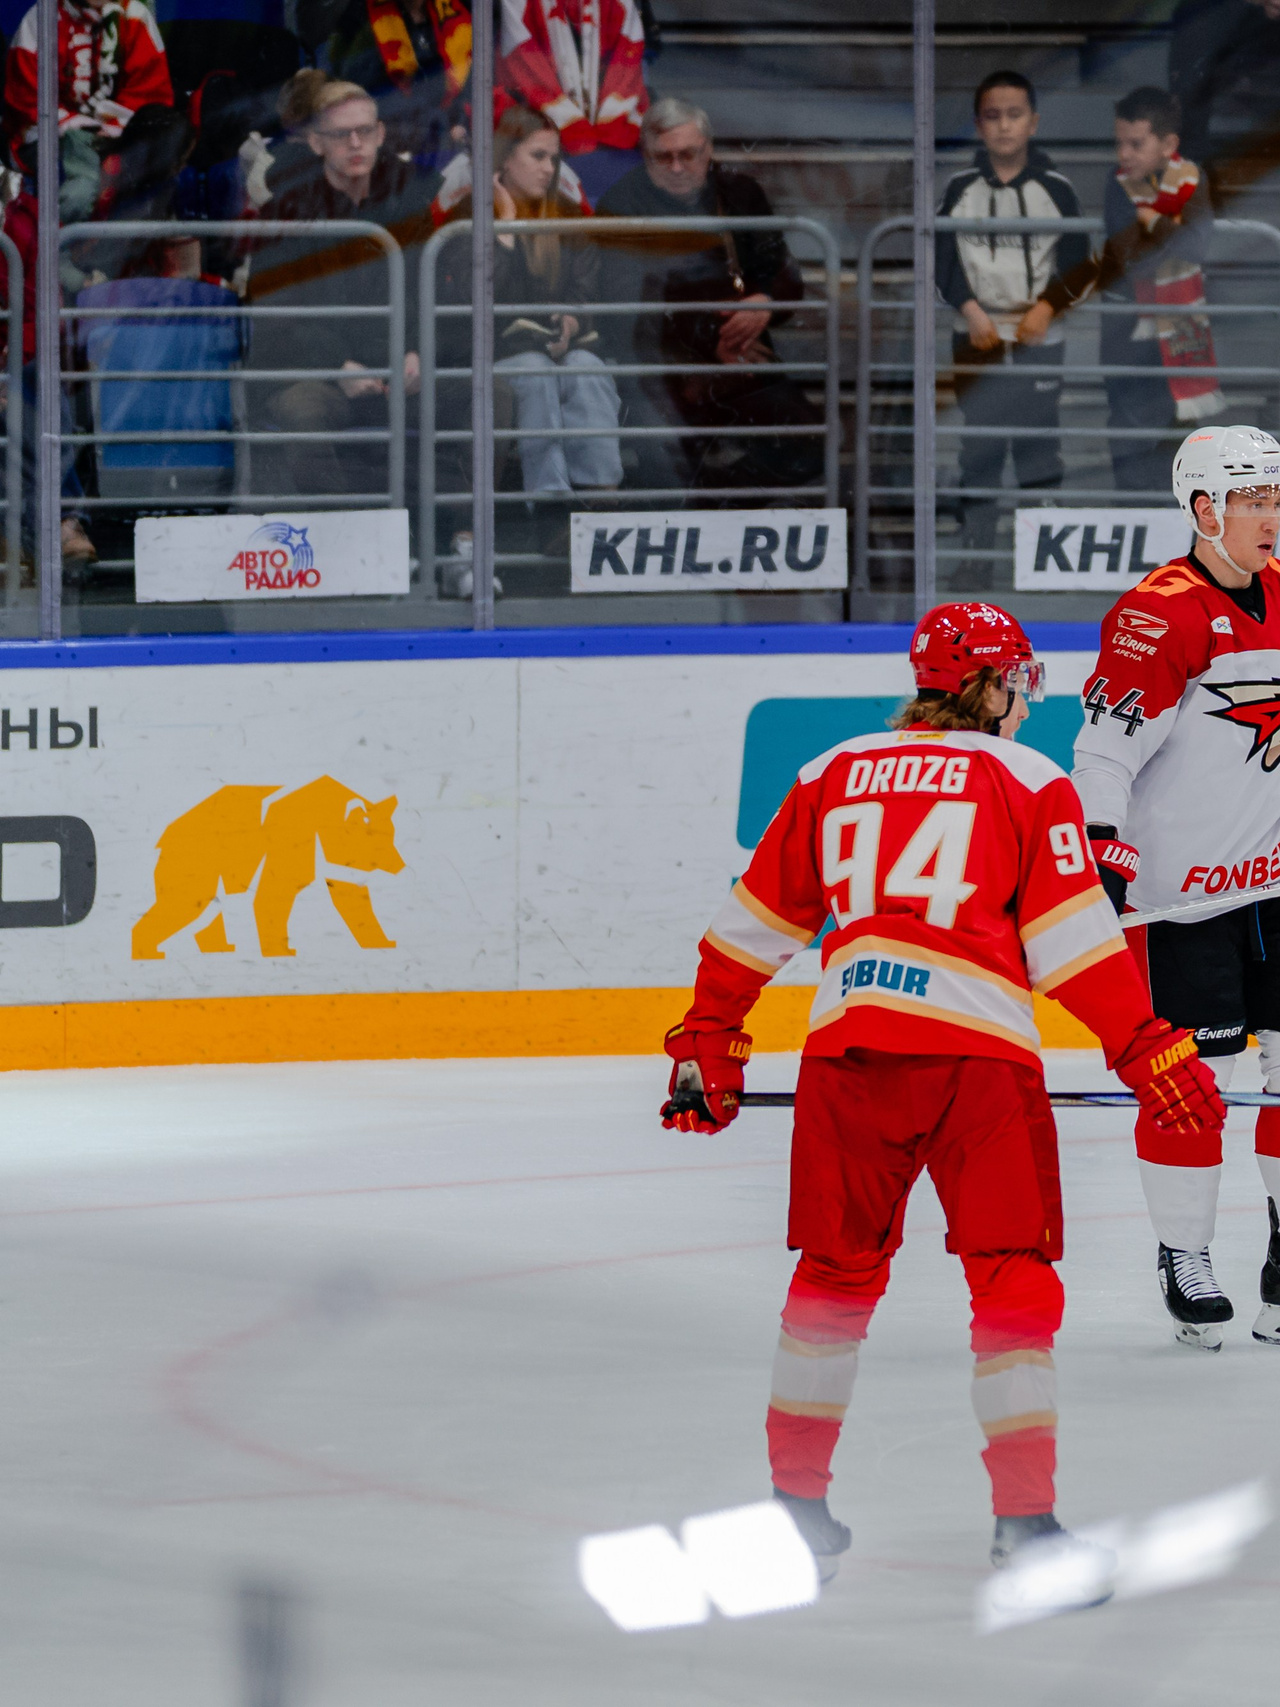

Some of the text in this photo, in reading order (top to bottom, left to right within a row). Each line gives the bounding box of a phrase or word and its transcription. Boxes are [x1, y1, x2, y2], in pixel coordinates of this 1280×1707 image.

[227, 549, 288, 571] АВТО
[589, 525, 829, 575] KHL.RU
[1033, 524, 1161, 573] KHL
[245, 568, 321, 590] РАДИО
[916, 633, 930, 653] 94
[973, 646, 1002, 654] CCM
[1084, 676, 1144, 737] 44
[845, 755, 970, 798] DROZG
[822, 800, 978, 930] 94
[1049, 822, 1098, 875] 9
[841, 959, 931, 997] SIBUR
